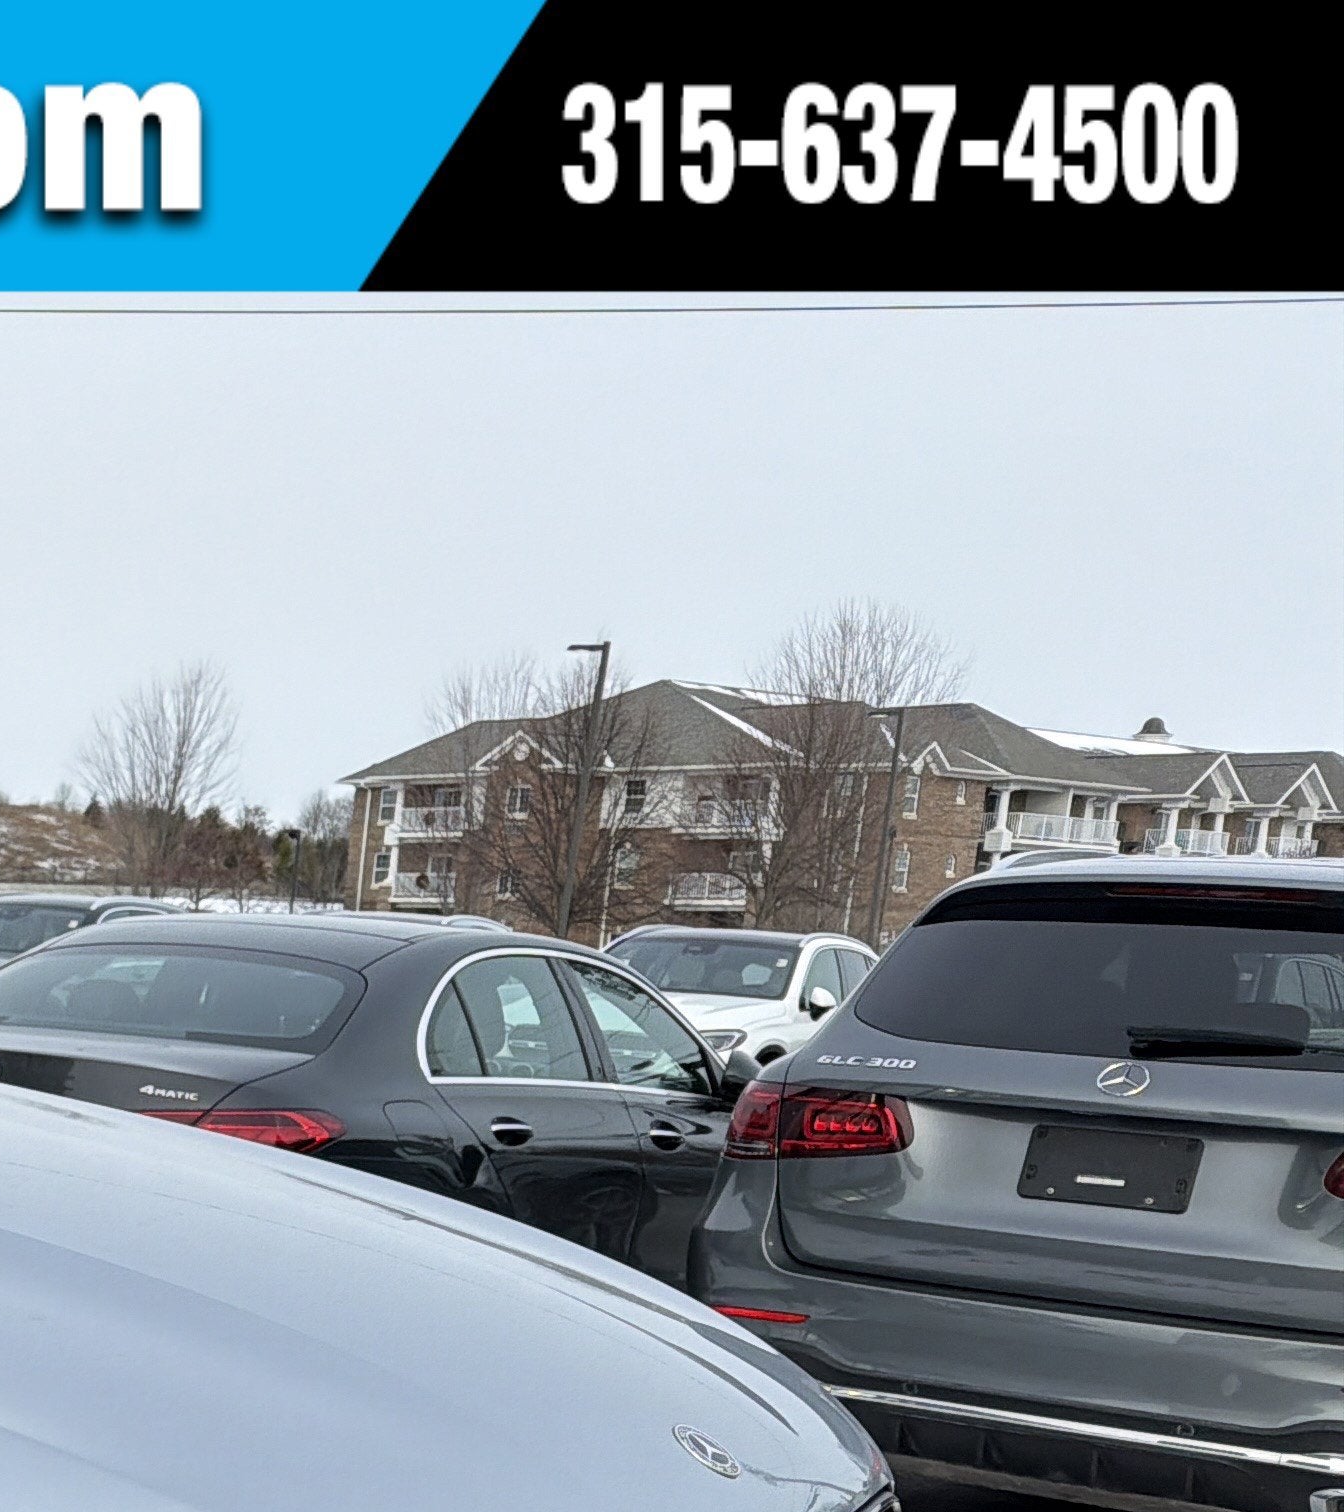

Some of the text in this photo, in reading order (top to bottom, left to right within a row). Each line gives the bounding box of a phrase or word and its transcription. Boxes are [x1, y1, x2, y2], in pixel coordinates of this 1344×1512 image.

[817, 1054, 917, 1070] GLC 300
[138, 1084, 199, 1101] 4MATIC
